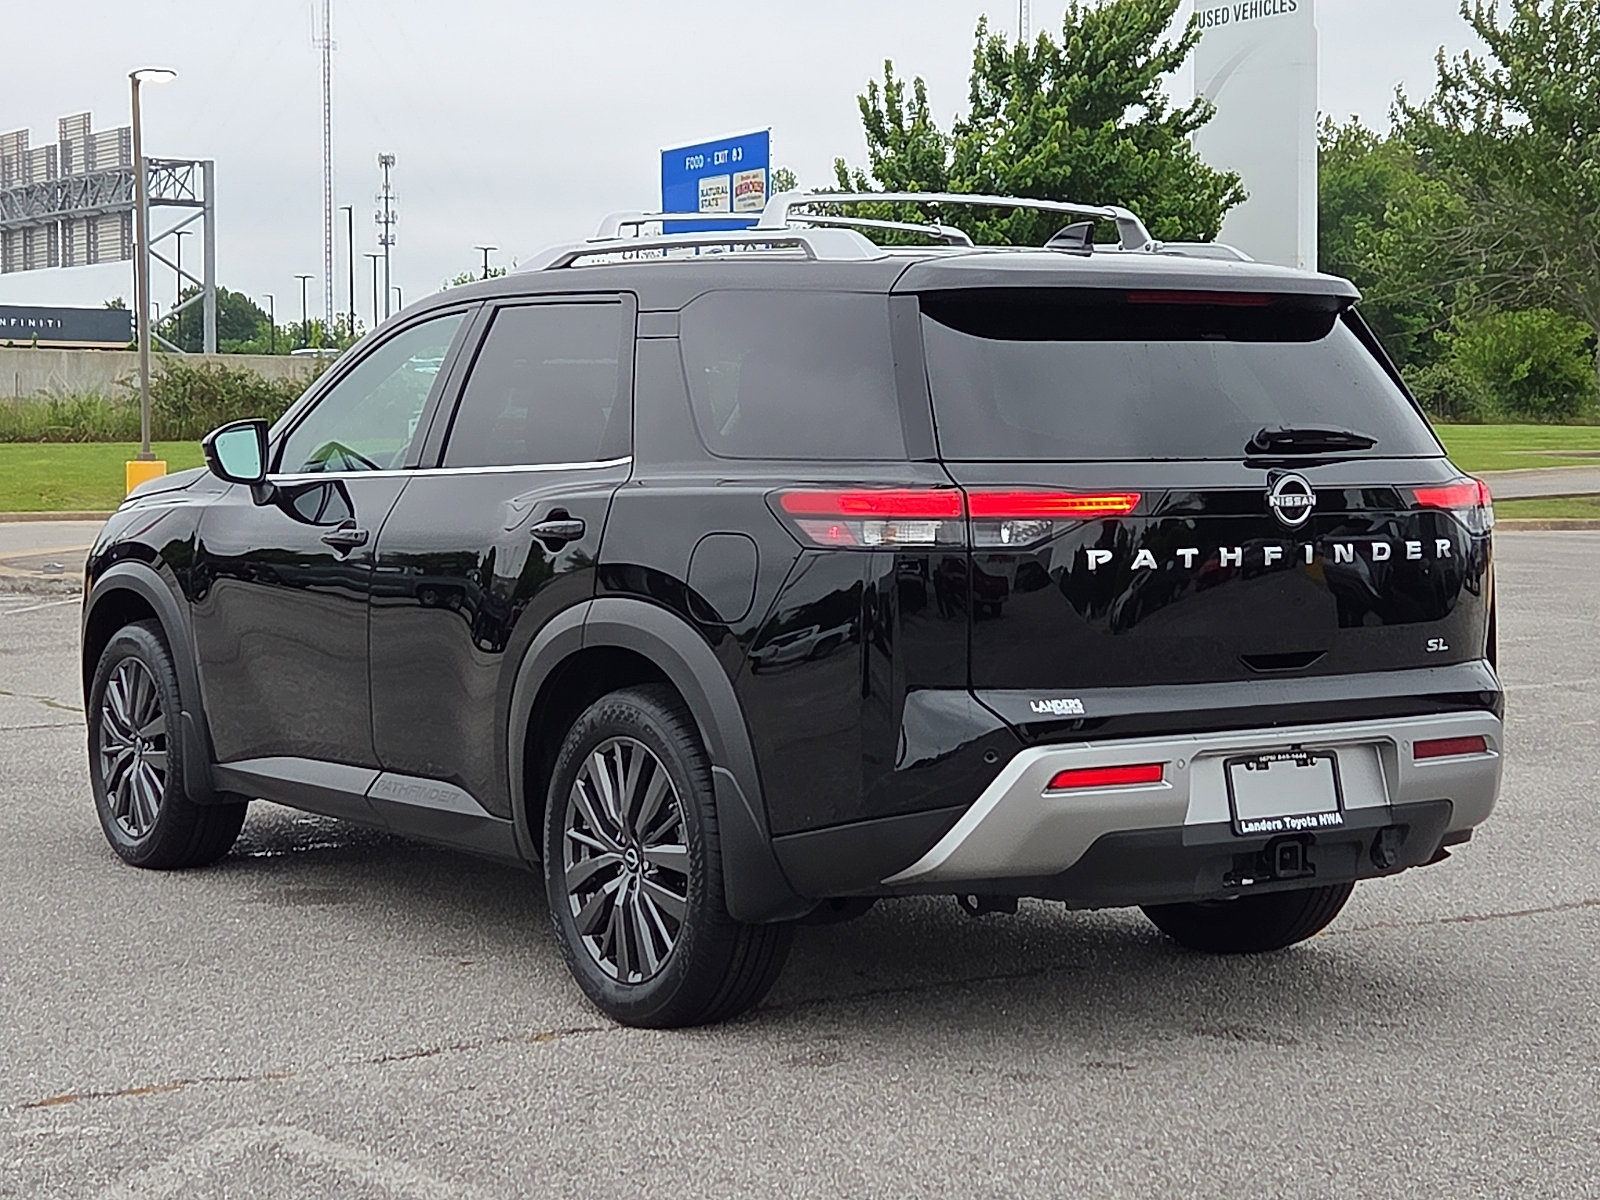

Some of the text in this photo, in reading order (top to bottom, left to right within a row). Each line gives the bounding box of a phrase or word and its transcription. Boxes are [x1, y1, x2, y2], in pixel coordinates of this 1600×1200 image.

[1198, 0, 1297, 29] USED VEHICLES
[685, 154, 704, 170] FOOD
[714, 149, 728, 165] EXIT
[1269, 494, 1316, 507] NISSAN
[1085, 538, 1453, 571] PATHFINDER
[1426, 637, 1448, 653] SL
[1030, 698, 1083, 713] LANDERS
[374, 778, 461, 805] PATHFINDER
[1241, 812, 1343, 833] Landers Toyota NWA
